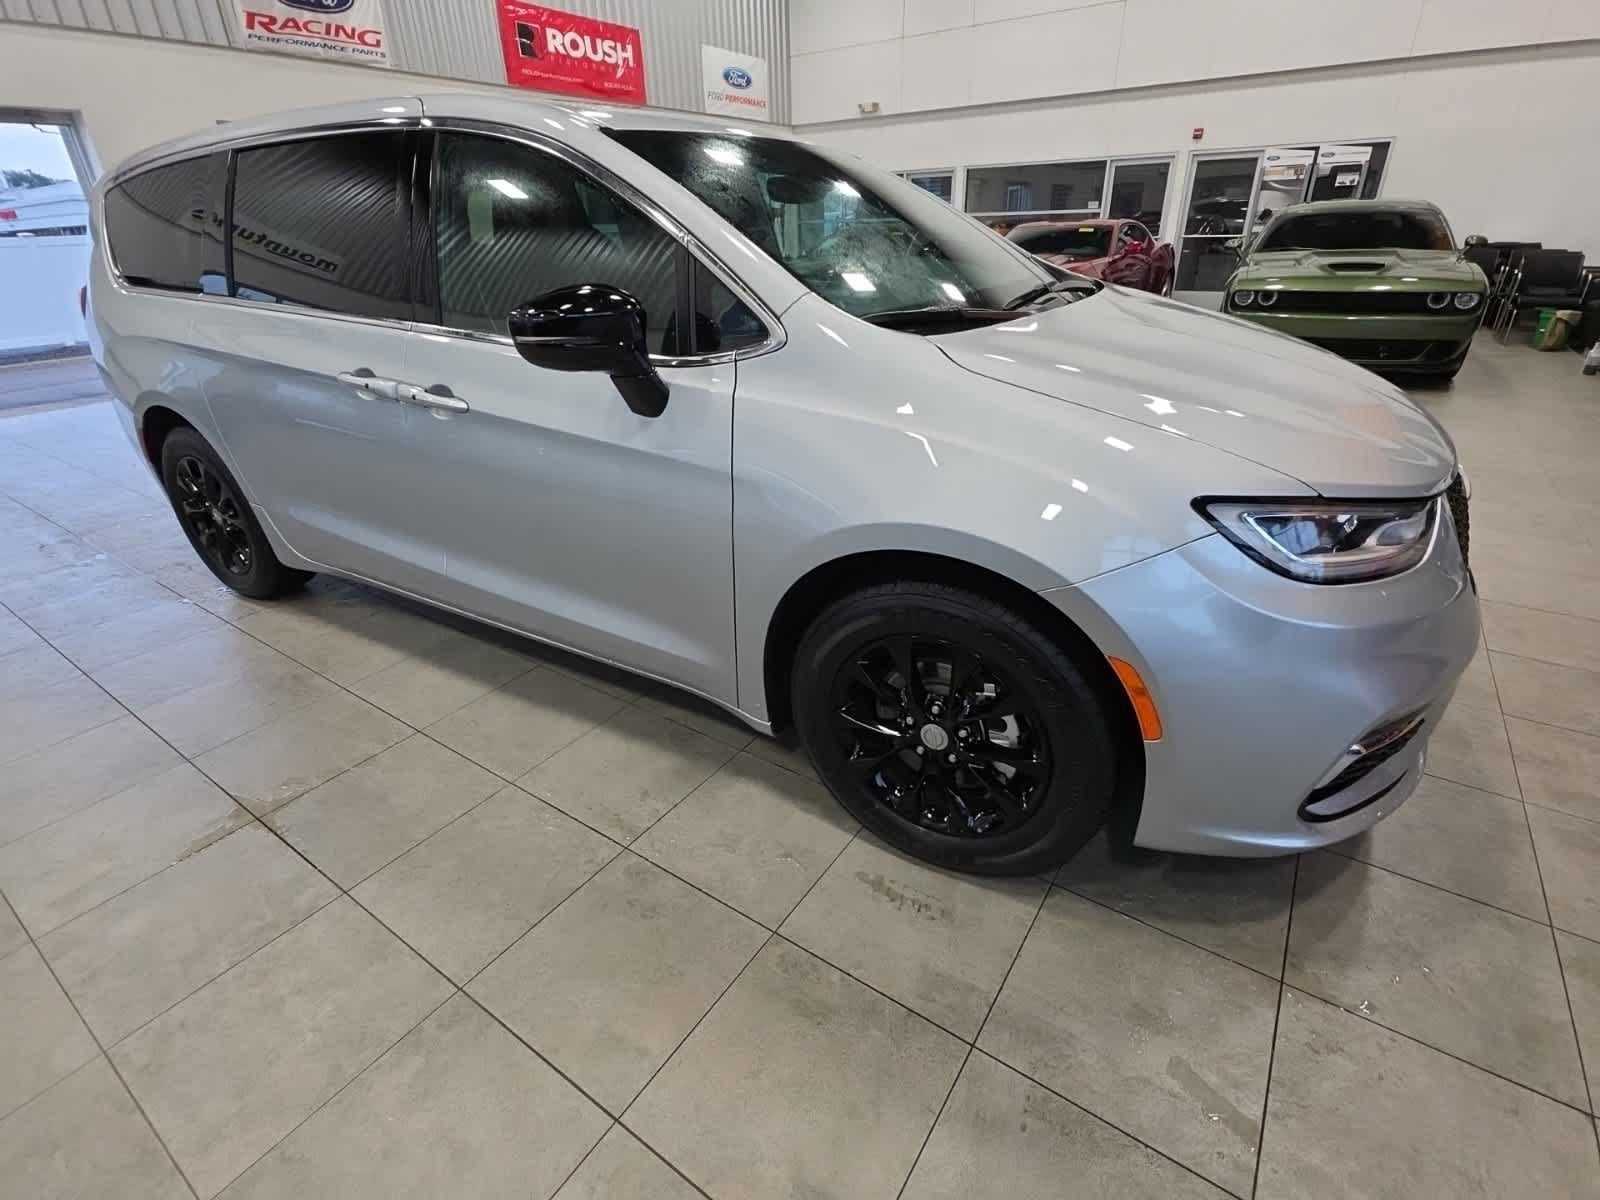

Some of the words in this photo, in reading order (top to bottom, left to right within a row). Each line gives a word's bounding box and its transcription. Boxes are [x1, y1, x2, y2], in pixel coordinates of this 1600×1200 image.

[244, 11, 383, 48] RACING
[248, 33, 346, 52] PERFORMANCE
[351, 47, 386, 59] PARTS
[545, 27, 635, 78] ROUSH
[724, 94, 767, 108] PERFORMANCE
